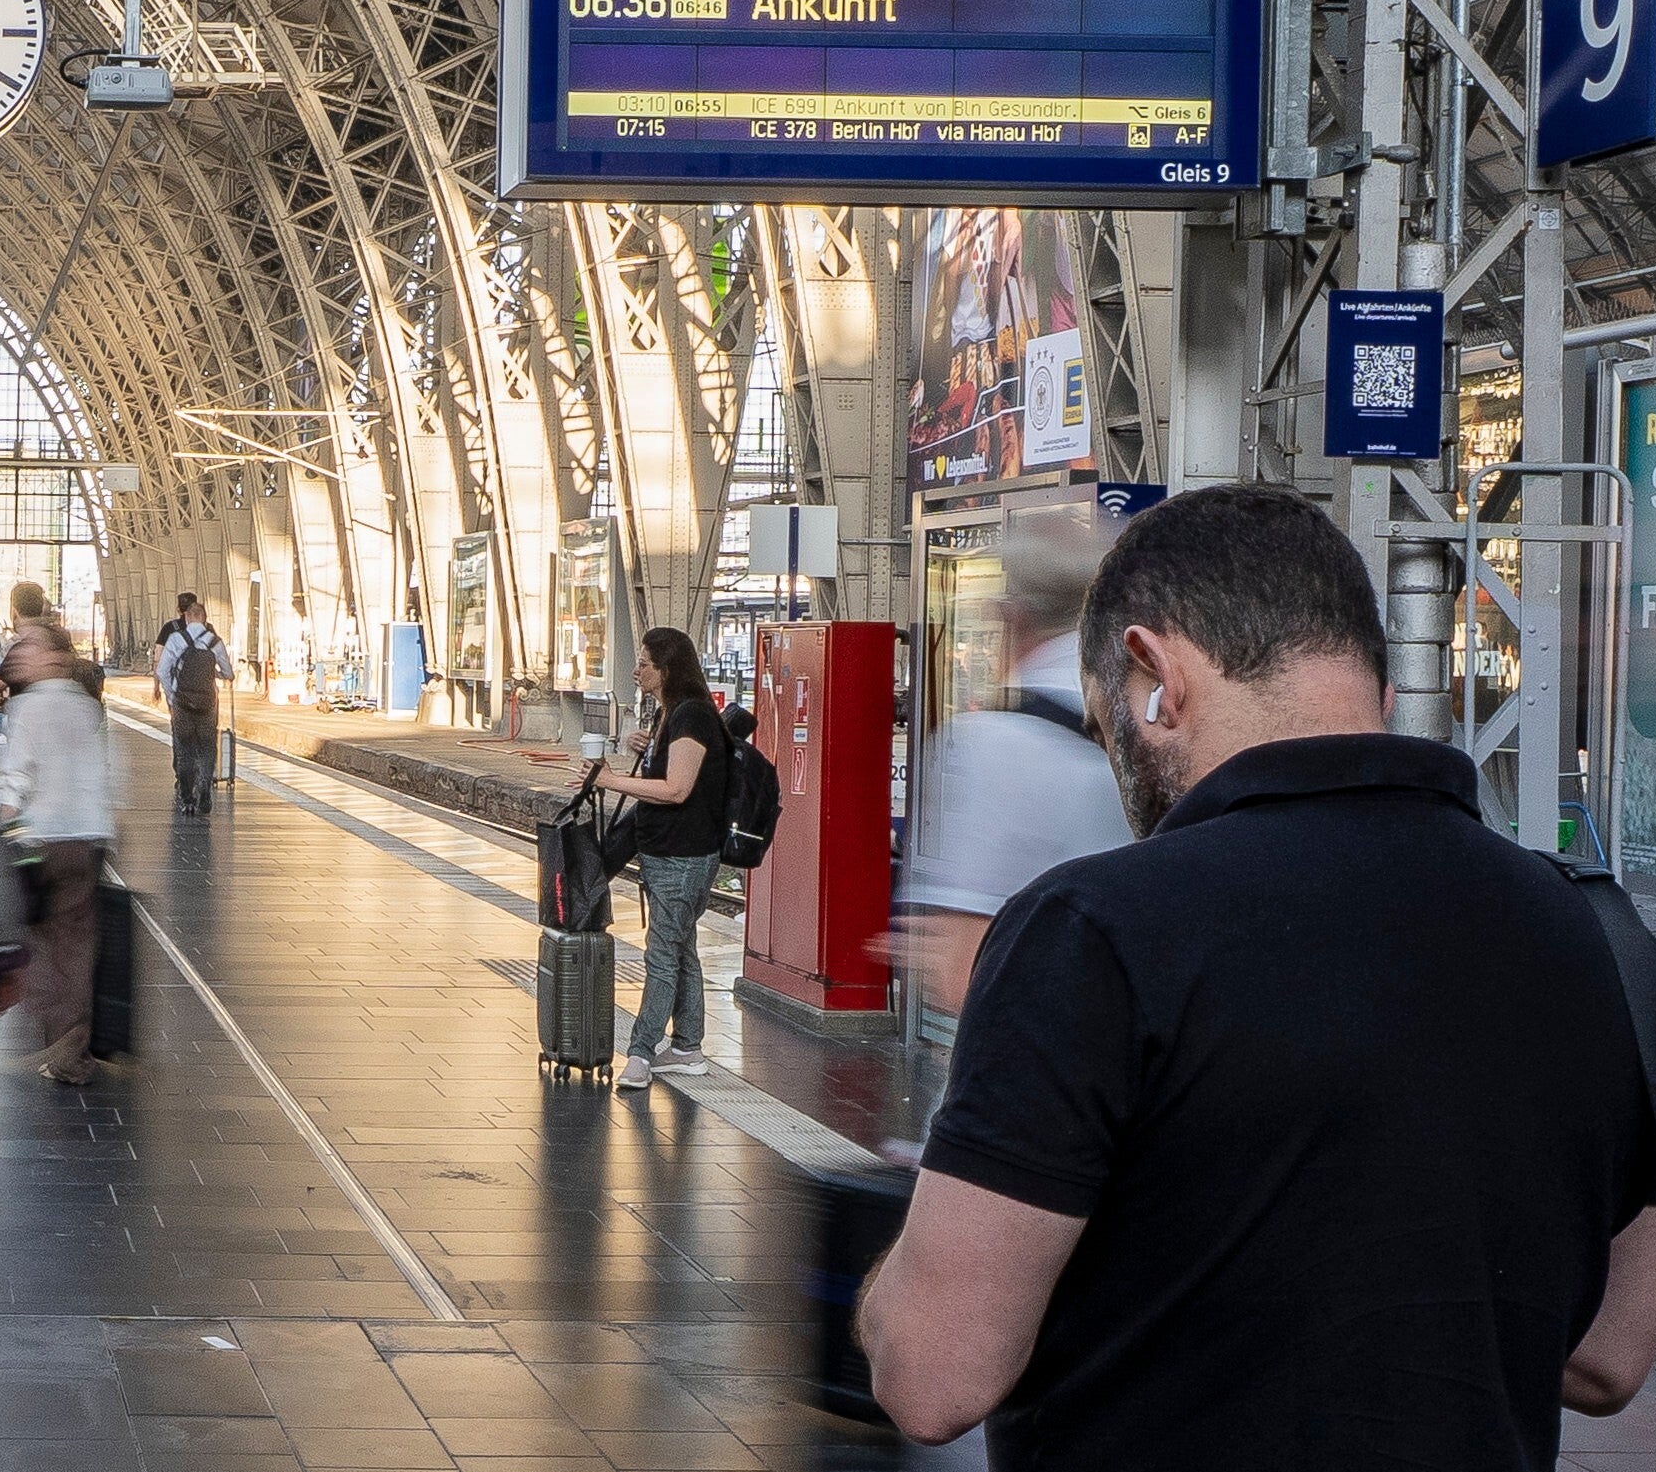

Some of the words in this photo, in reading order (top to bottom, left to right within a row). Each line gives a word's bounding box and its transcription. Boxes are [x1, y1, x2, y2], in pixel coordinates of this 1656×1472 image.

[675, 0, 722, 14] 06:46
[617, 96, 665, 112] 03:10
[674, 99, 721, 113] 06:55
[752, 97, 776, 114] ICE
[785, 98, 817, 114] 699
[834, 99, 907, 116] Ankunft
[913, 102, 946, 117] von
[954, 101, 982, 117] Bln
[989, 101, 1077, 119] Gesundbr.
[1155, 106, 1192, 120] Gleis
[1197, 107, 1206, 120] 6
[617, 119, 665, 137] 07:15
[750, 120, 777, 138] ICE
[784, 121, 817, 139] 378
[832, 121, 884, 140] Berlin
[890, 122, 921, 141] Hbf
[937, 124, 964, 141] via
[970, 124, 1025, 142] Hanau
[1031, 124, 1062, 142] Hbf
[1175, 127, 1208, 144] A-F
[1160, 163, 1211, 183] Gleis
[1217, 164, 1230, 183] 9
[1340, 303, 1356, 311] Live
